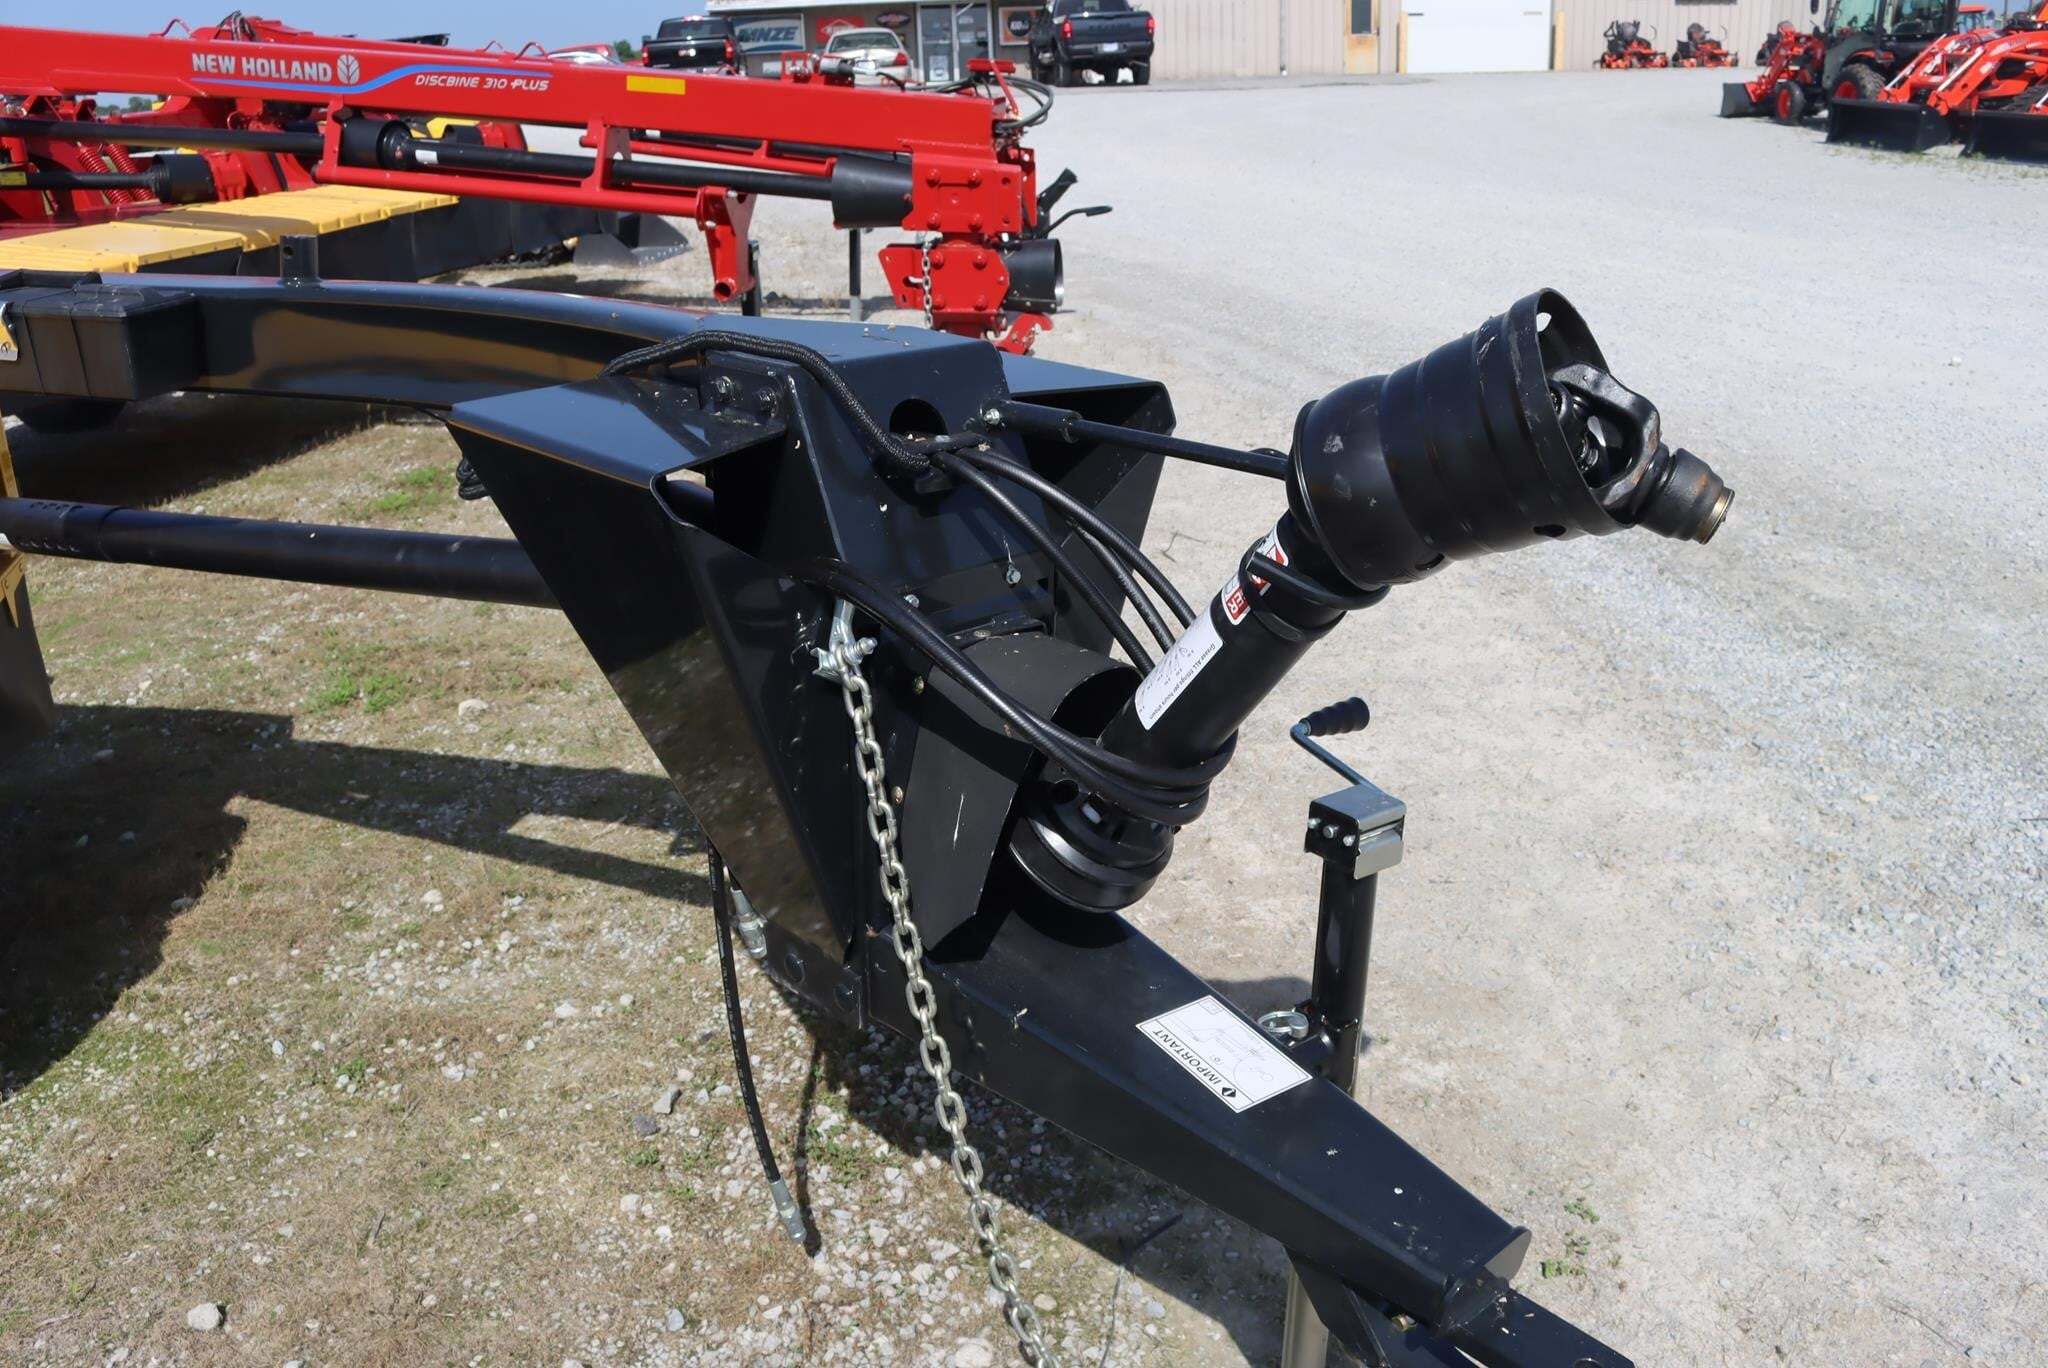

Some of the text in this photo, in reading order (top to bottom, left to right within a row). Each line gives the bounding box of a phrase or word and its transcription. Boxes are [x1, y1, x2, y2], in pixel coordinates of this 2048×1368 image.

[191, 53, 333, 82] NEW HOLLAND
[415, 74, 480, 88] DISCBINE
[483, 77, 508, 89] 310
[1193, 659, 1202, 670] ALL
[1152, 1029, 1222, 1086] IMPORTANT
